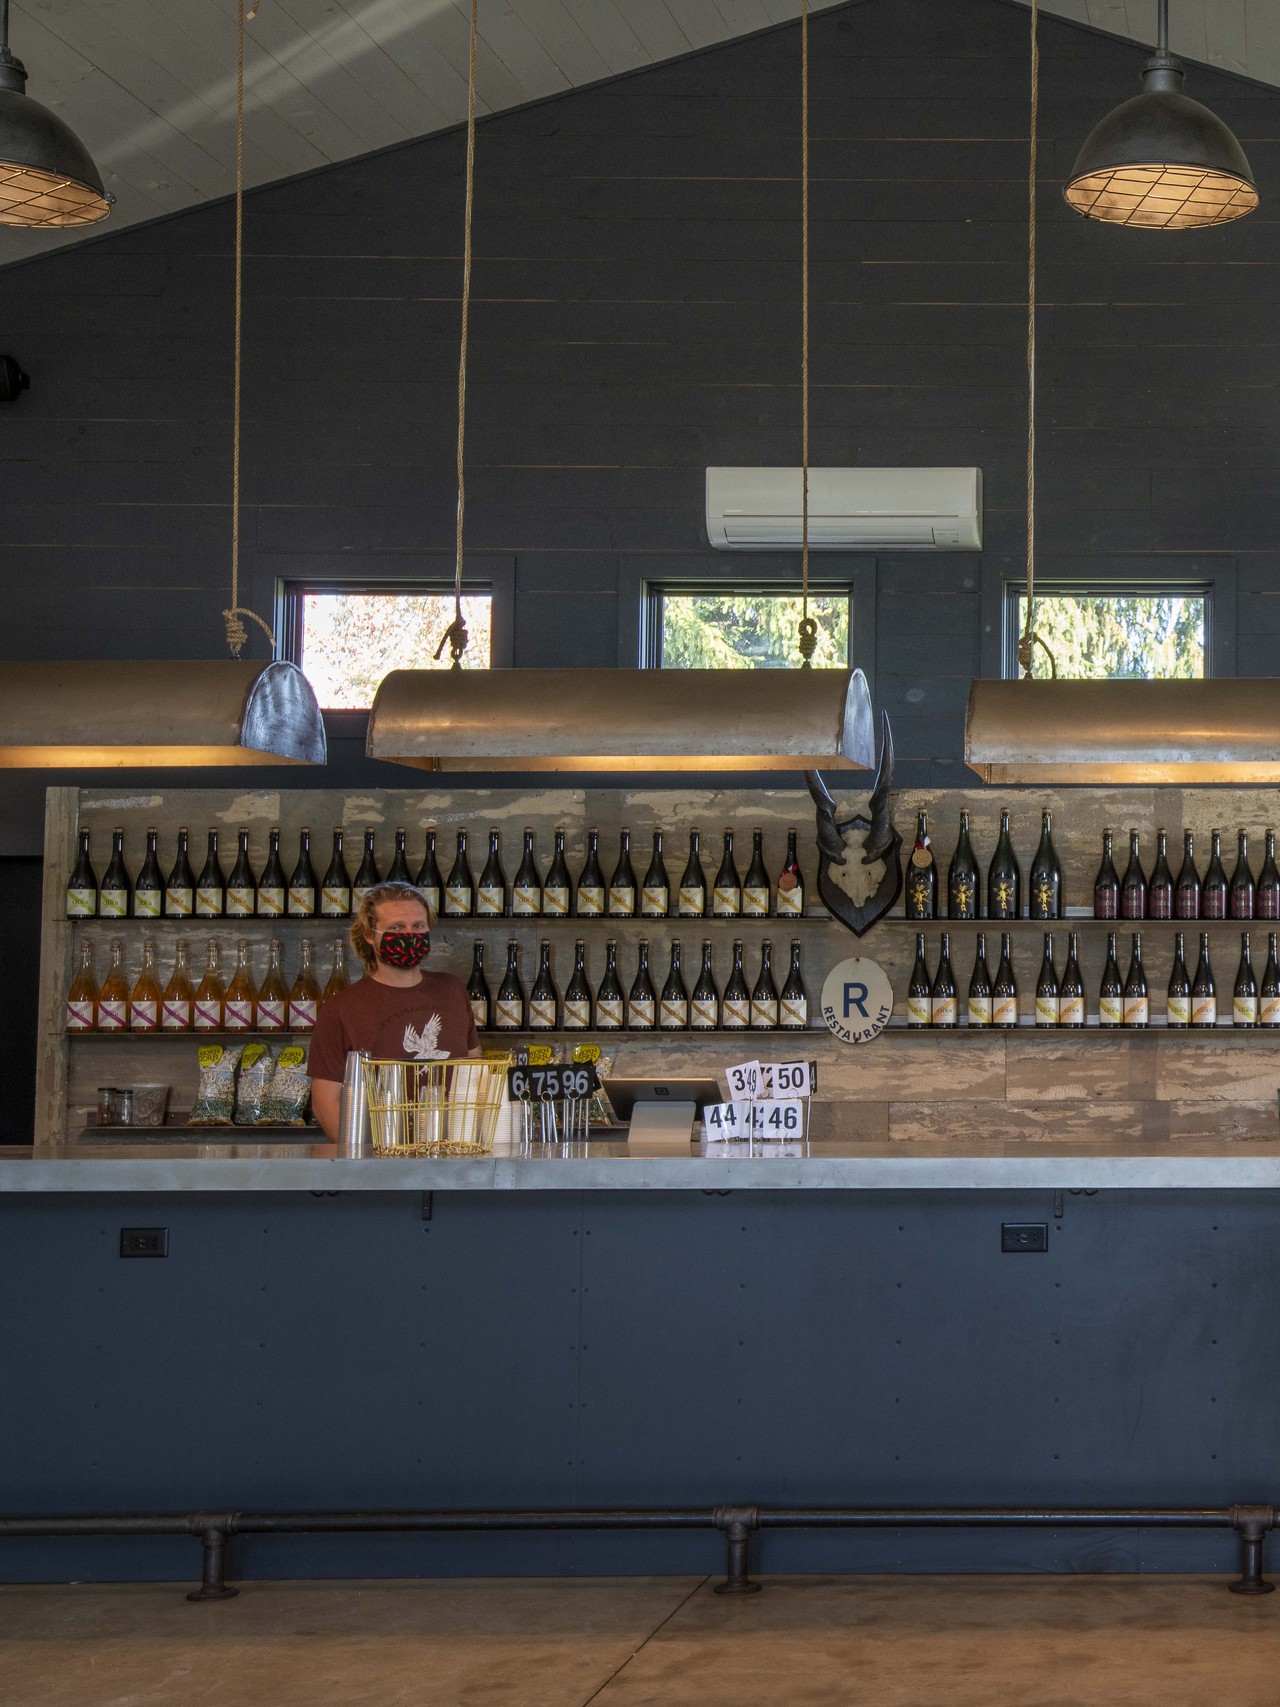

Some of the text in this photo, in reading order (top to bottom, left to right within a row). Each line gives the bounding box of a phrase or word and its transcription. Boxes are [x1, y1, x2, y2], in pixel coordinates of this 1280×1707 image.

[844, 983, 870, 1017] R
[823, 1005, 890, 1041] RESTAURANT
[532, 1070, 559, 1096] 75
[562, 1070, 588, 1096] 96
[778, 1066, 804, 1090] 50
[710, 1104, 736, 1128] 44
[768, 1106, 798, 1129] 46
